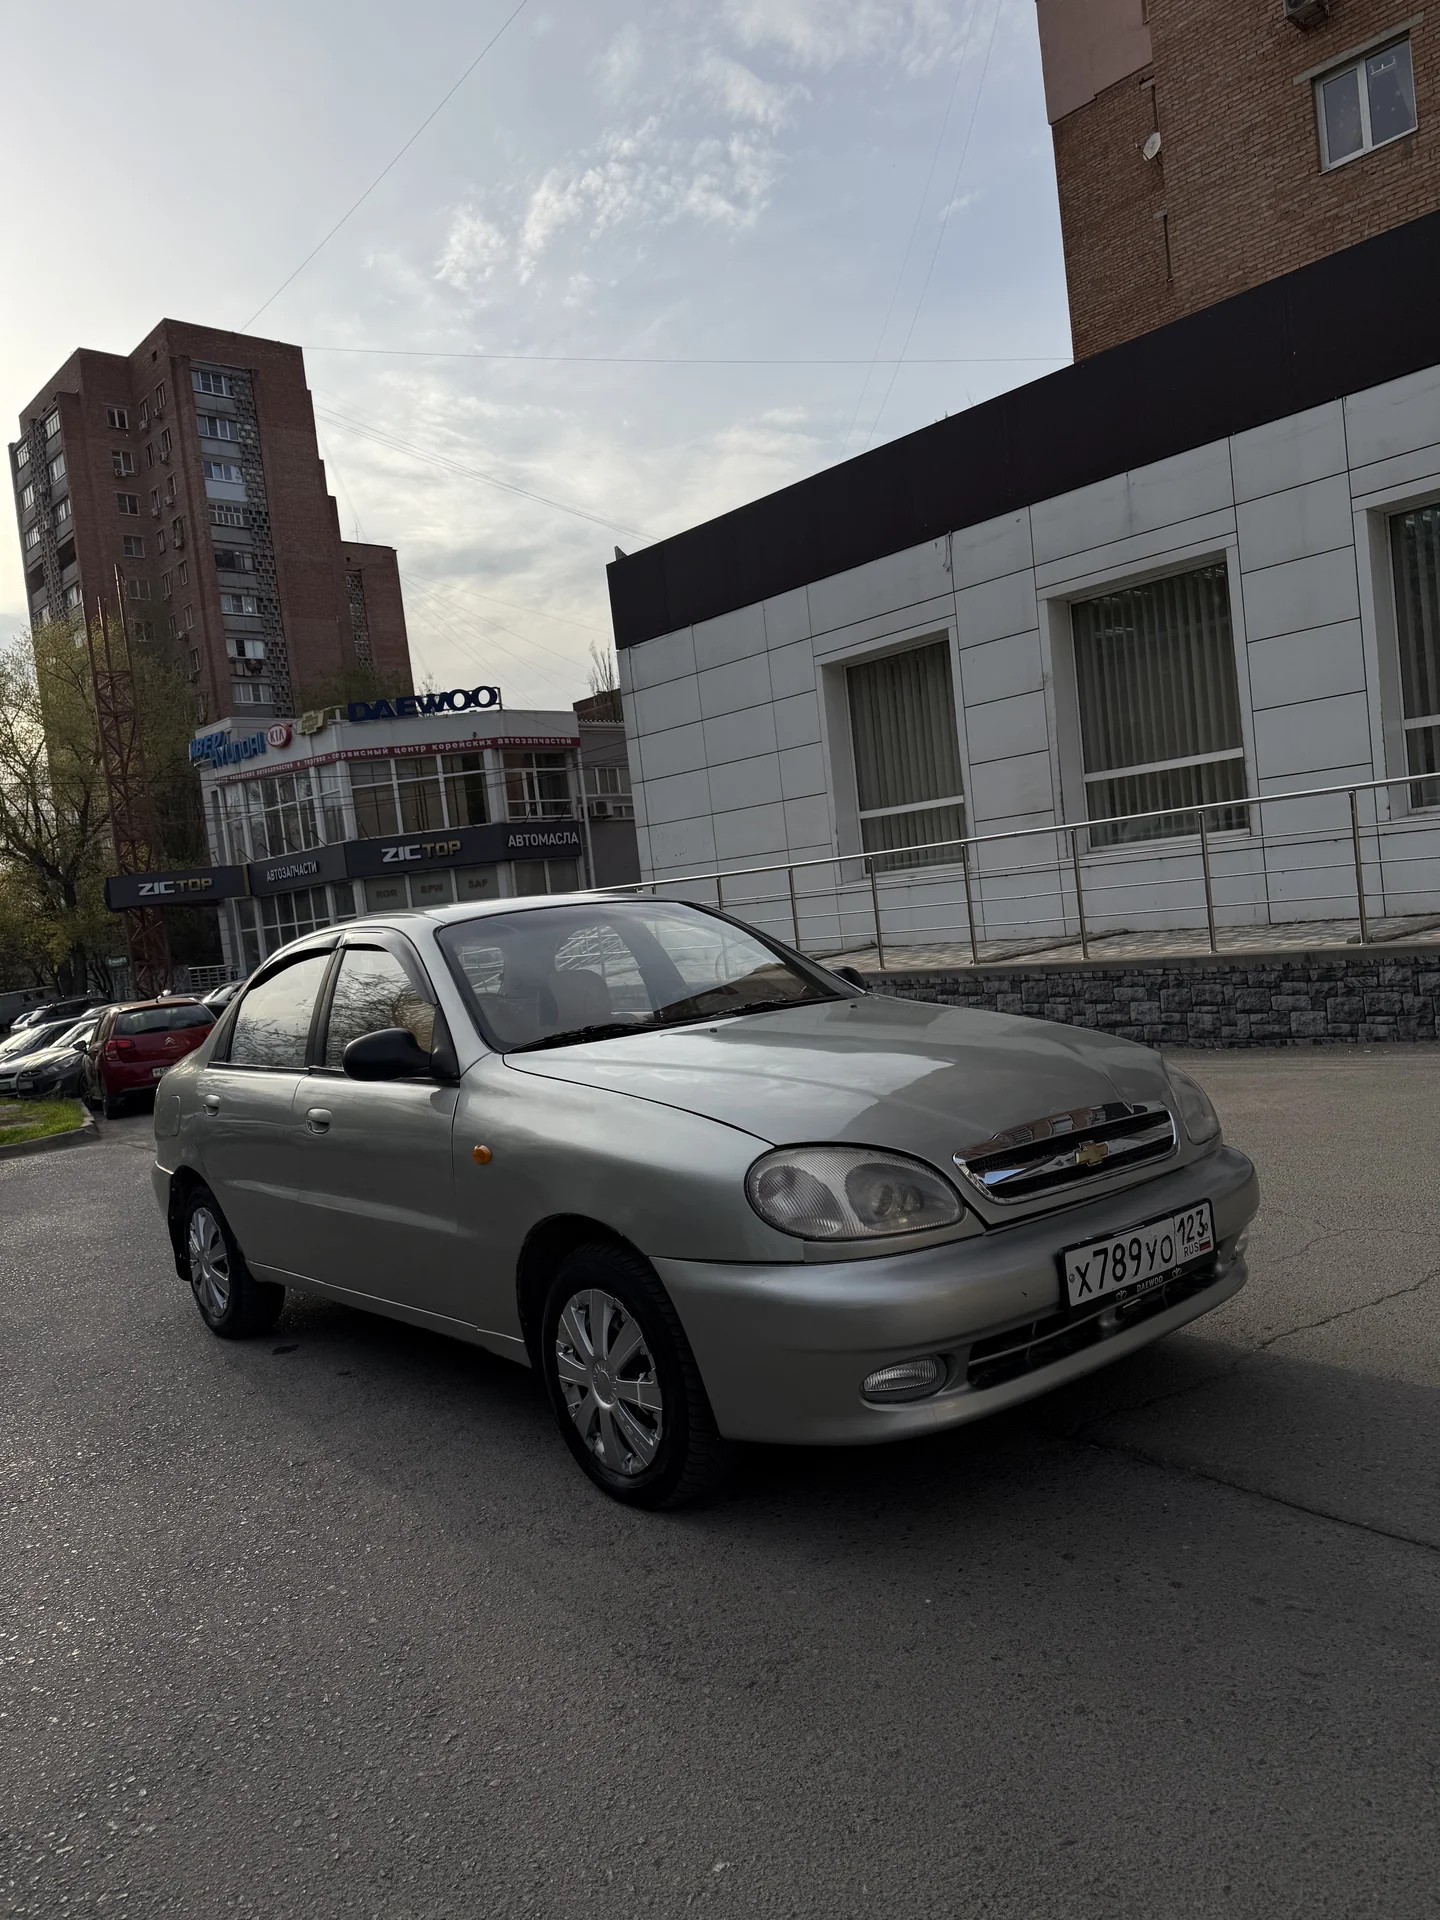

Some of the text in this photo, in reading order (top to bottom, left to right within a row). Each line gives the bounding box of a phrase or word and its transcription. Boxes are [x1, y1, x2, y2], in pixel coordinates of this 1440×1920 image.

[347, 686, 498, 722] DAEWOO
[269, 728, 285, 743] KIA
[394, 744, 427, 754] центр
[432, 738, 493, 752] корейских
[497, 736, 572, 745] автозапчастей
[209, 732, 267, 768] HYUNDAI
[507, 831, 580, 848] АВТОМАСЛА
[381, 839, 462, 863] ZIC TOP
[266, 861, 319, 882] АВТОЗАПЧАСТИ
[137, 877, 214, 897] ZIC TOP
[1176, 1208, 1206, 1246] 123
[1183, 1241, 1200, 1258] RUS
[1136, 1275, 1164, 1293] DAEWOO
